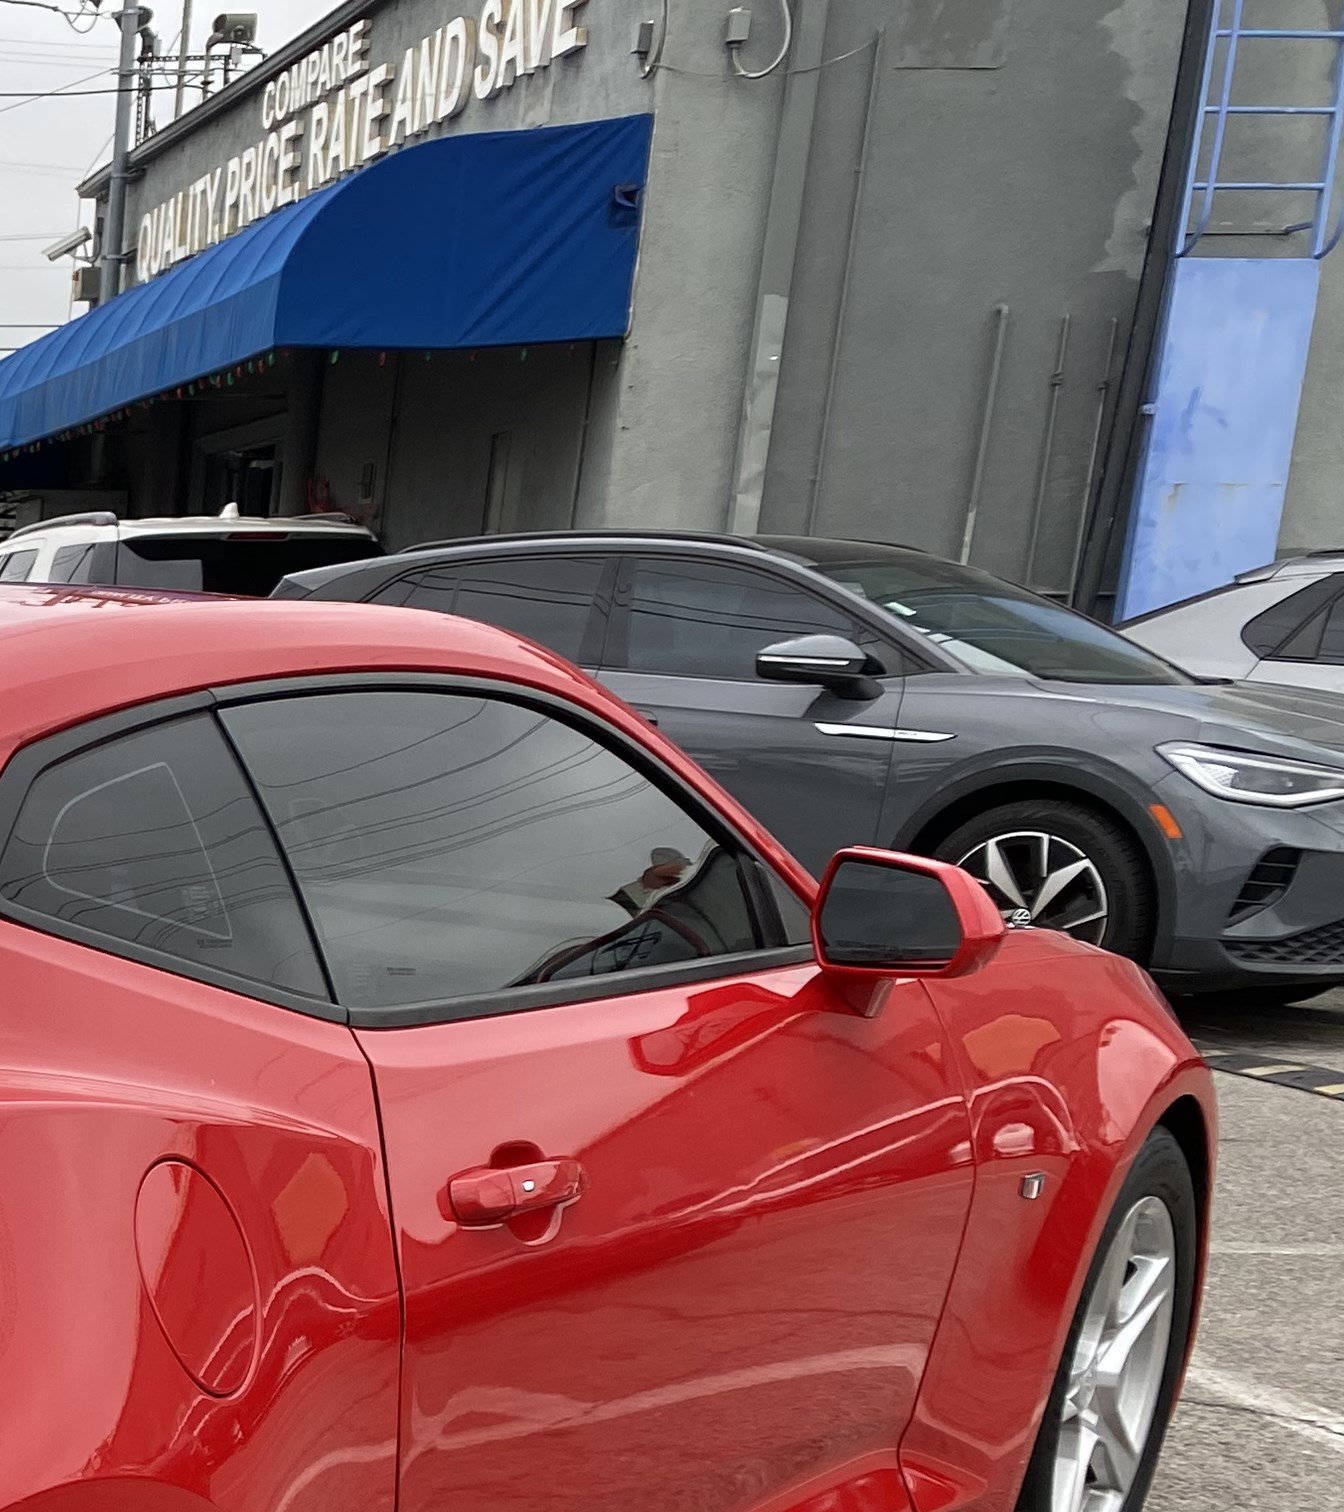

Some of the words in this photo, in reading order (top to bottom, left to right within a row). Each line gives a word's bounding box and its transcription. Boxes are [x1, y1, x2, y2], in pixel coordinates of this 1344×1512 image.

[262, 19, 371, 130] COMPARE
[308, 64, 393, 190] RATE
[389, 17, 475, 147] AND
[474, 0, 587, 99] SAVE
